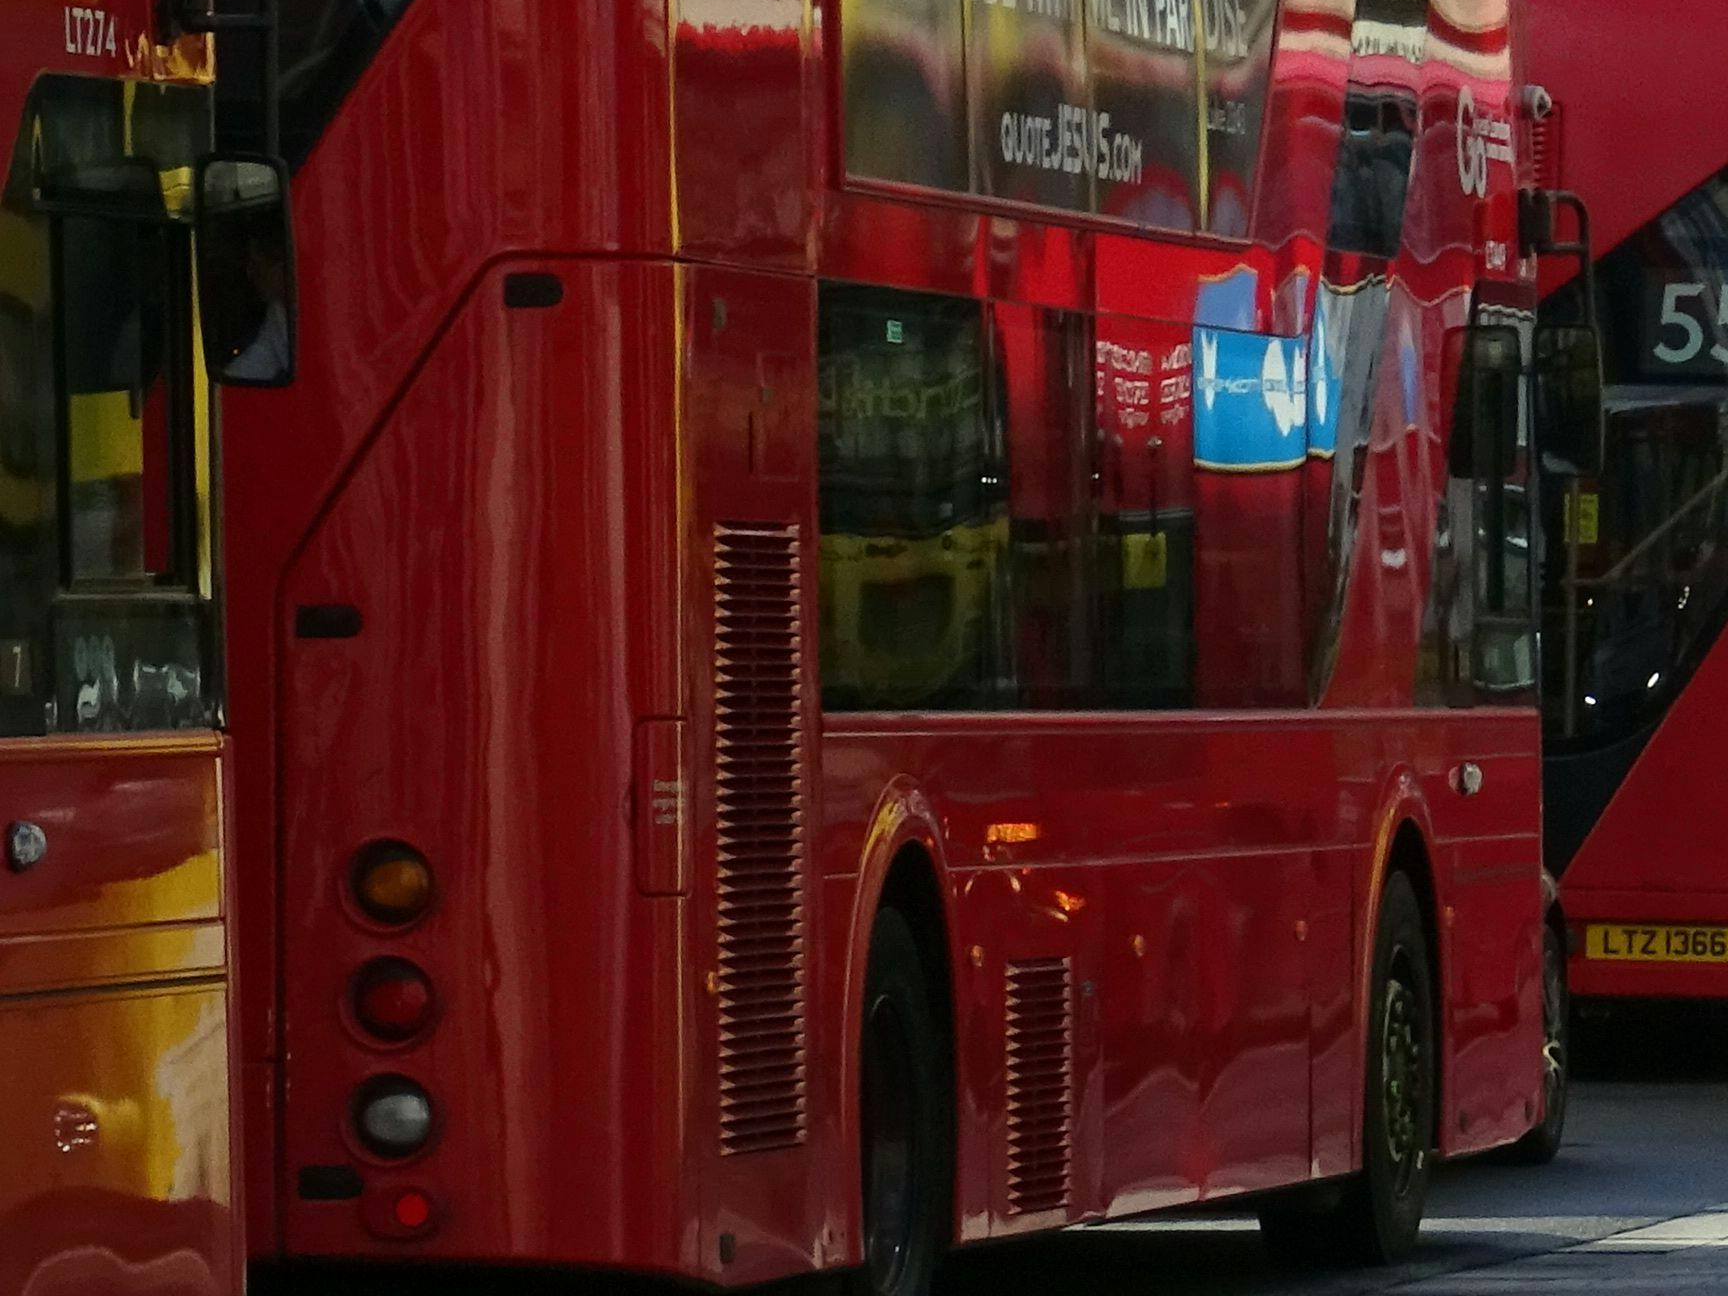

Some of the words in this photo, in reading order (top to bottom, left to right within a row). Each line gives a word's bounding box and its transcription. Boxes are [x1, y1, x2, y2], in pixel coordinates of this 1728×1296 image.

[65, 6, 116, 58] LT274
[1602, 928, 1657, 955] LTZ
[1664, 930, 1728, 957] 1366
